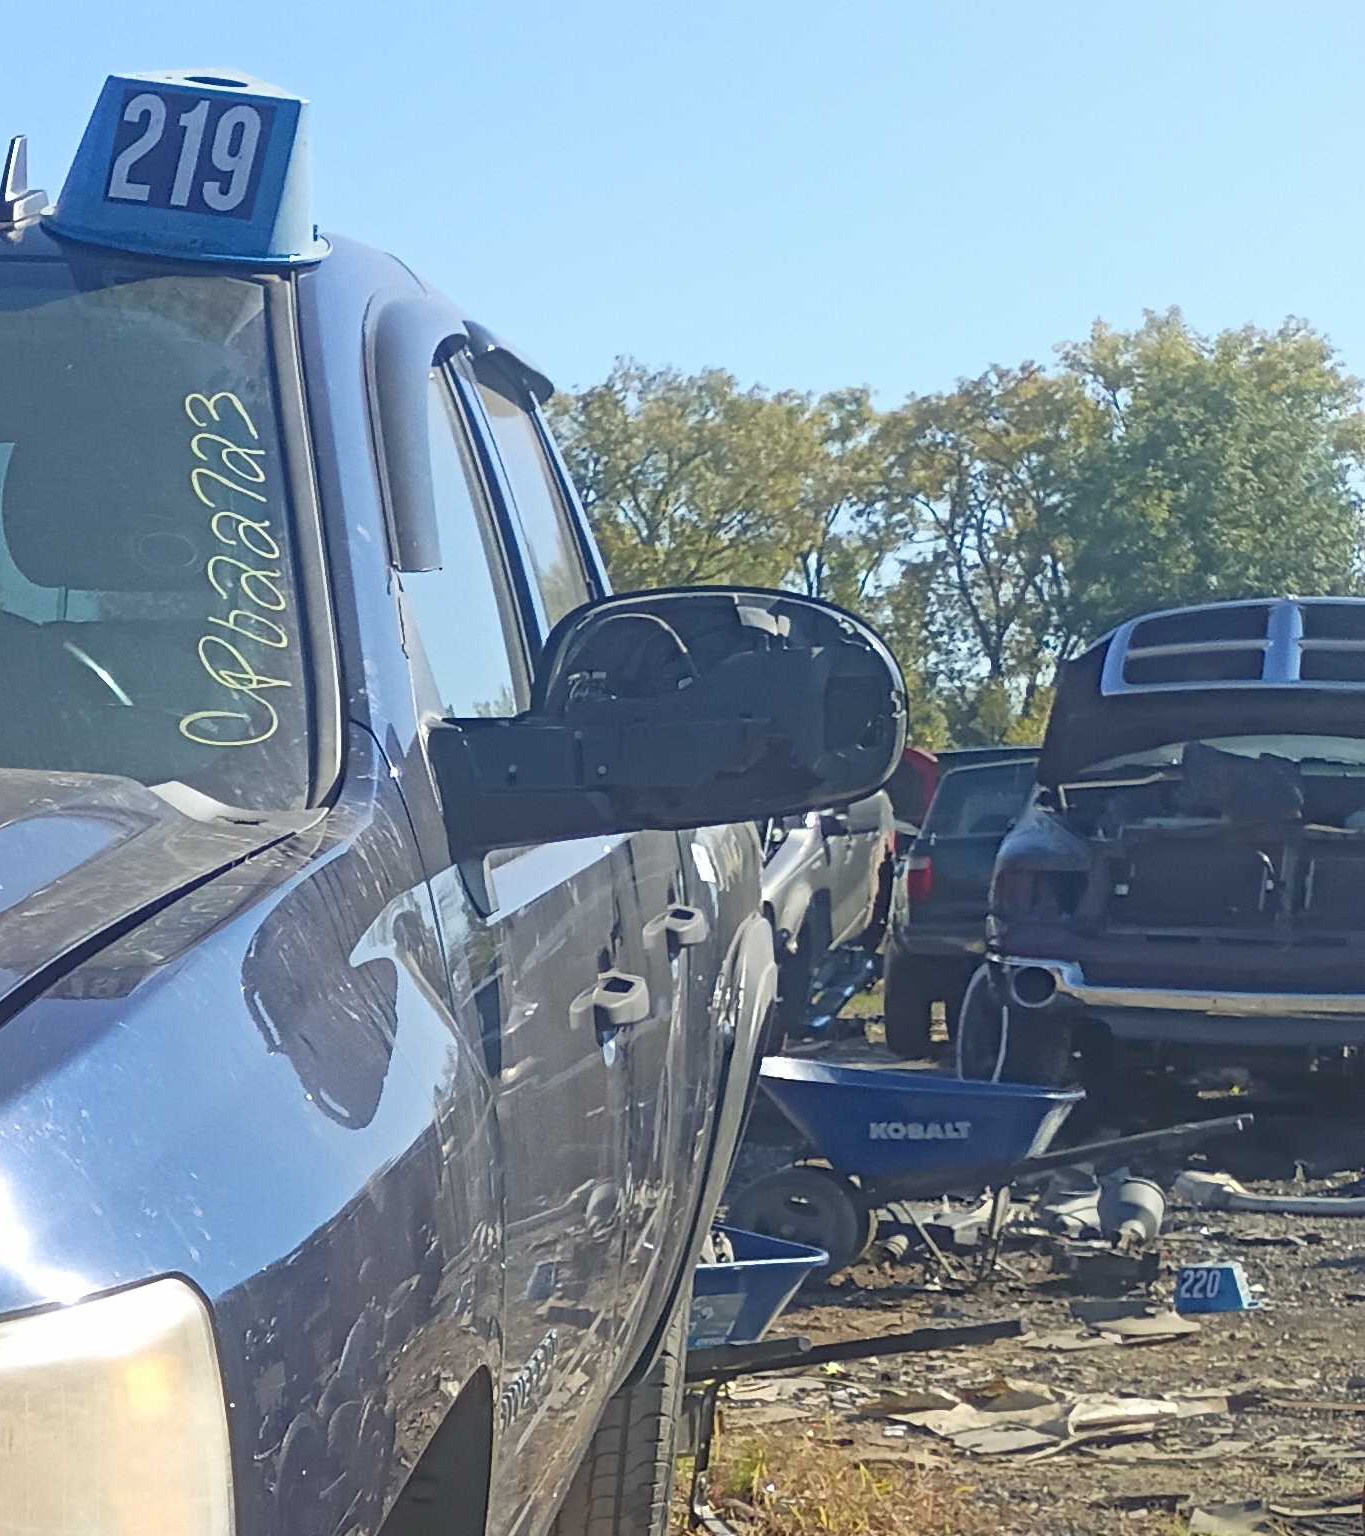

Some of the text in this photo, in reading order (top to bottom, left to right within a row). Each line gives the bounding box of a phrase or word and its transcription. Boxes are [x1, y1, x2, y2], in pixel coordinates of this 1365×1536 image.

[109, 93, 262, 211] 219
[869, 1121, 971, 1140] KOBALT
[1180, 1270, 1221, 1298] 220
